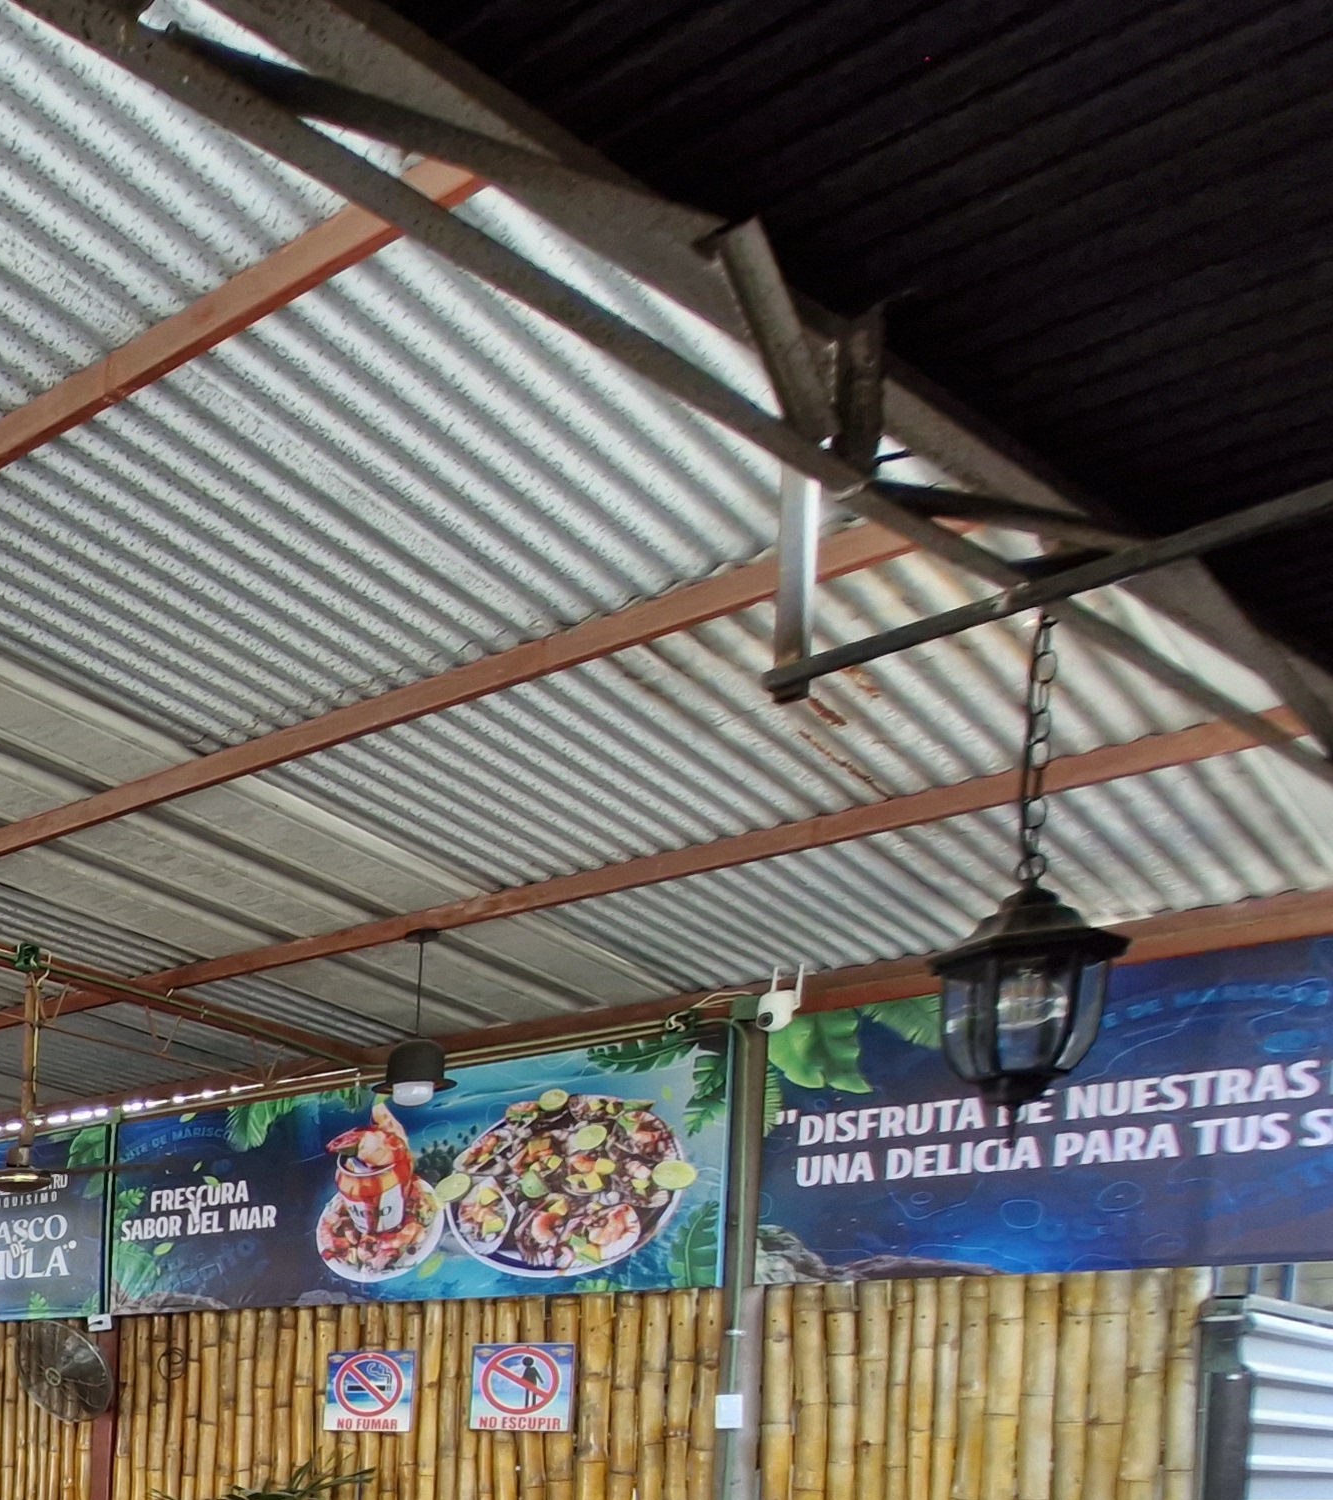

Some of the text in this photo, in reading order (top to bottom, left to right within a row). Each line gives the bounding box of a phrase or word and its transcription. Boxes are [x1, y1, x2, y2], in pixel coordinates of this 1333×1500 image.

[776, 1096, 985, 1147] "DISFRUTA
[1064, 1059, 1321, 1121] NUESTRAS
[172, 1125, 233, 1143] MARISCO
[796, 1107, 1333, 1188] UNA DELICIA PARA TUS S
[150, 1180, 249, 1214] FRESCURA
[120, 1204, 277, 1242] SABOR DEL MAR
[10, 1239, 30, 1259] DE
[336, 1417, 398, 1430] NO FUMAR
[479, 1416, 561, 1430] NO ESCUPIR
